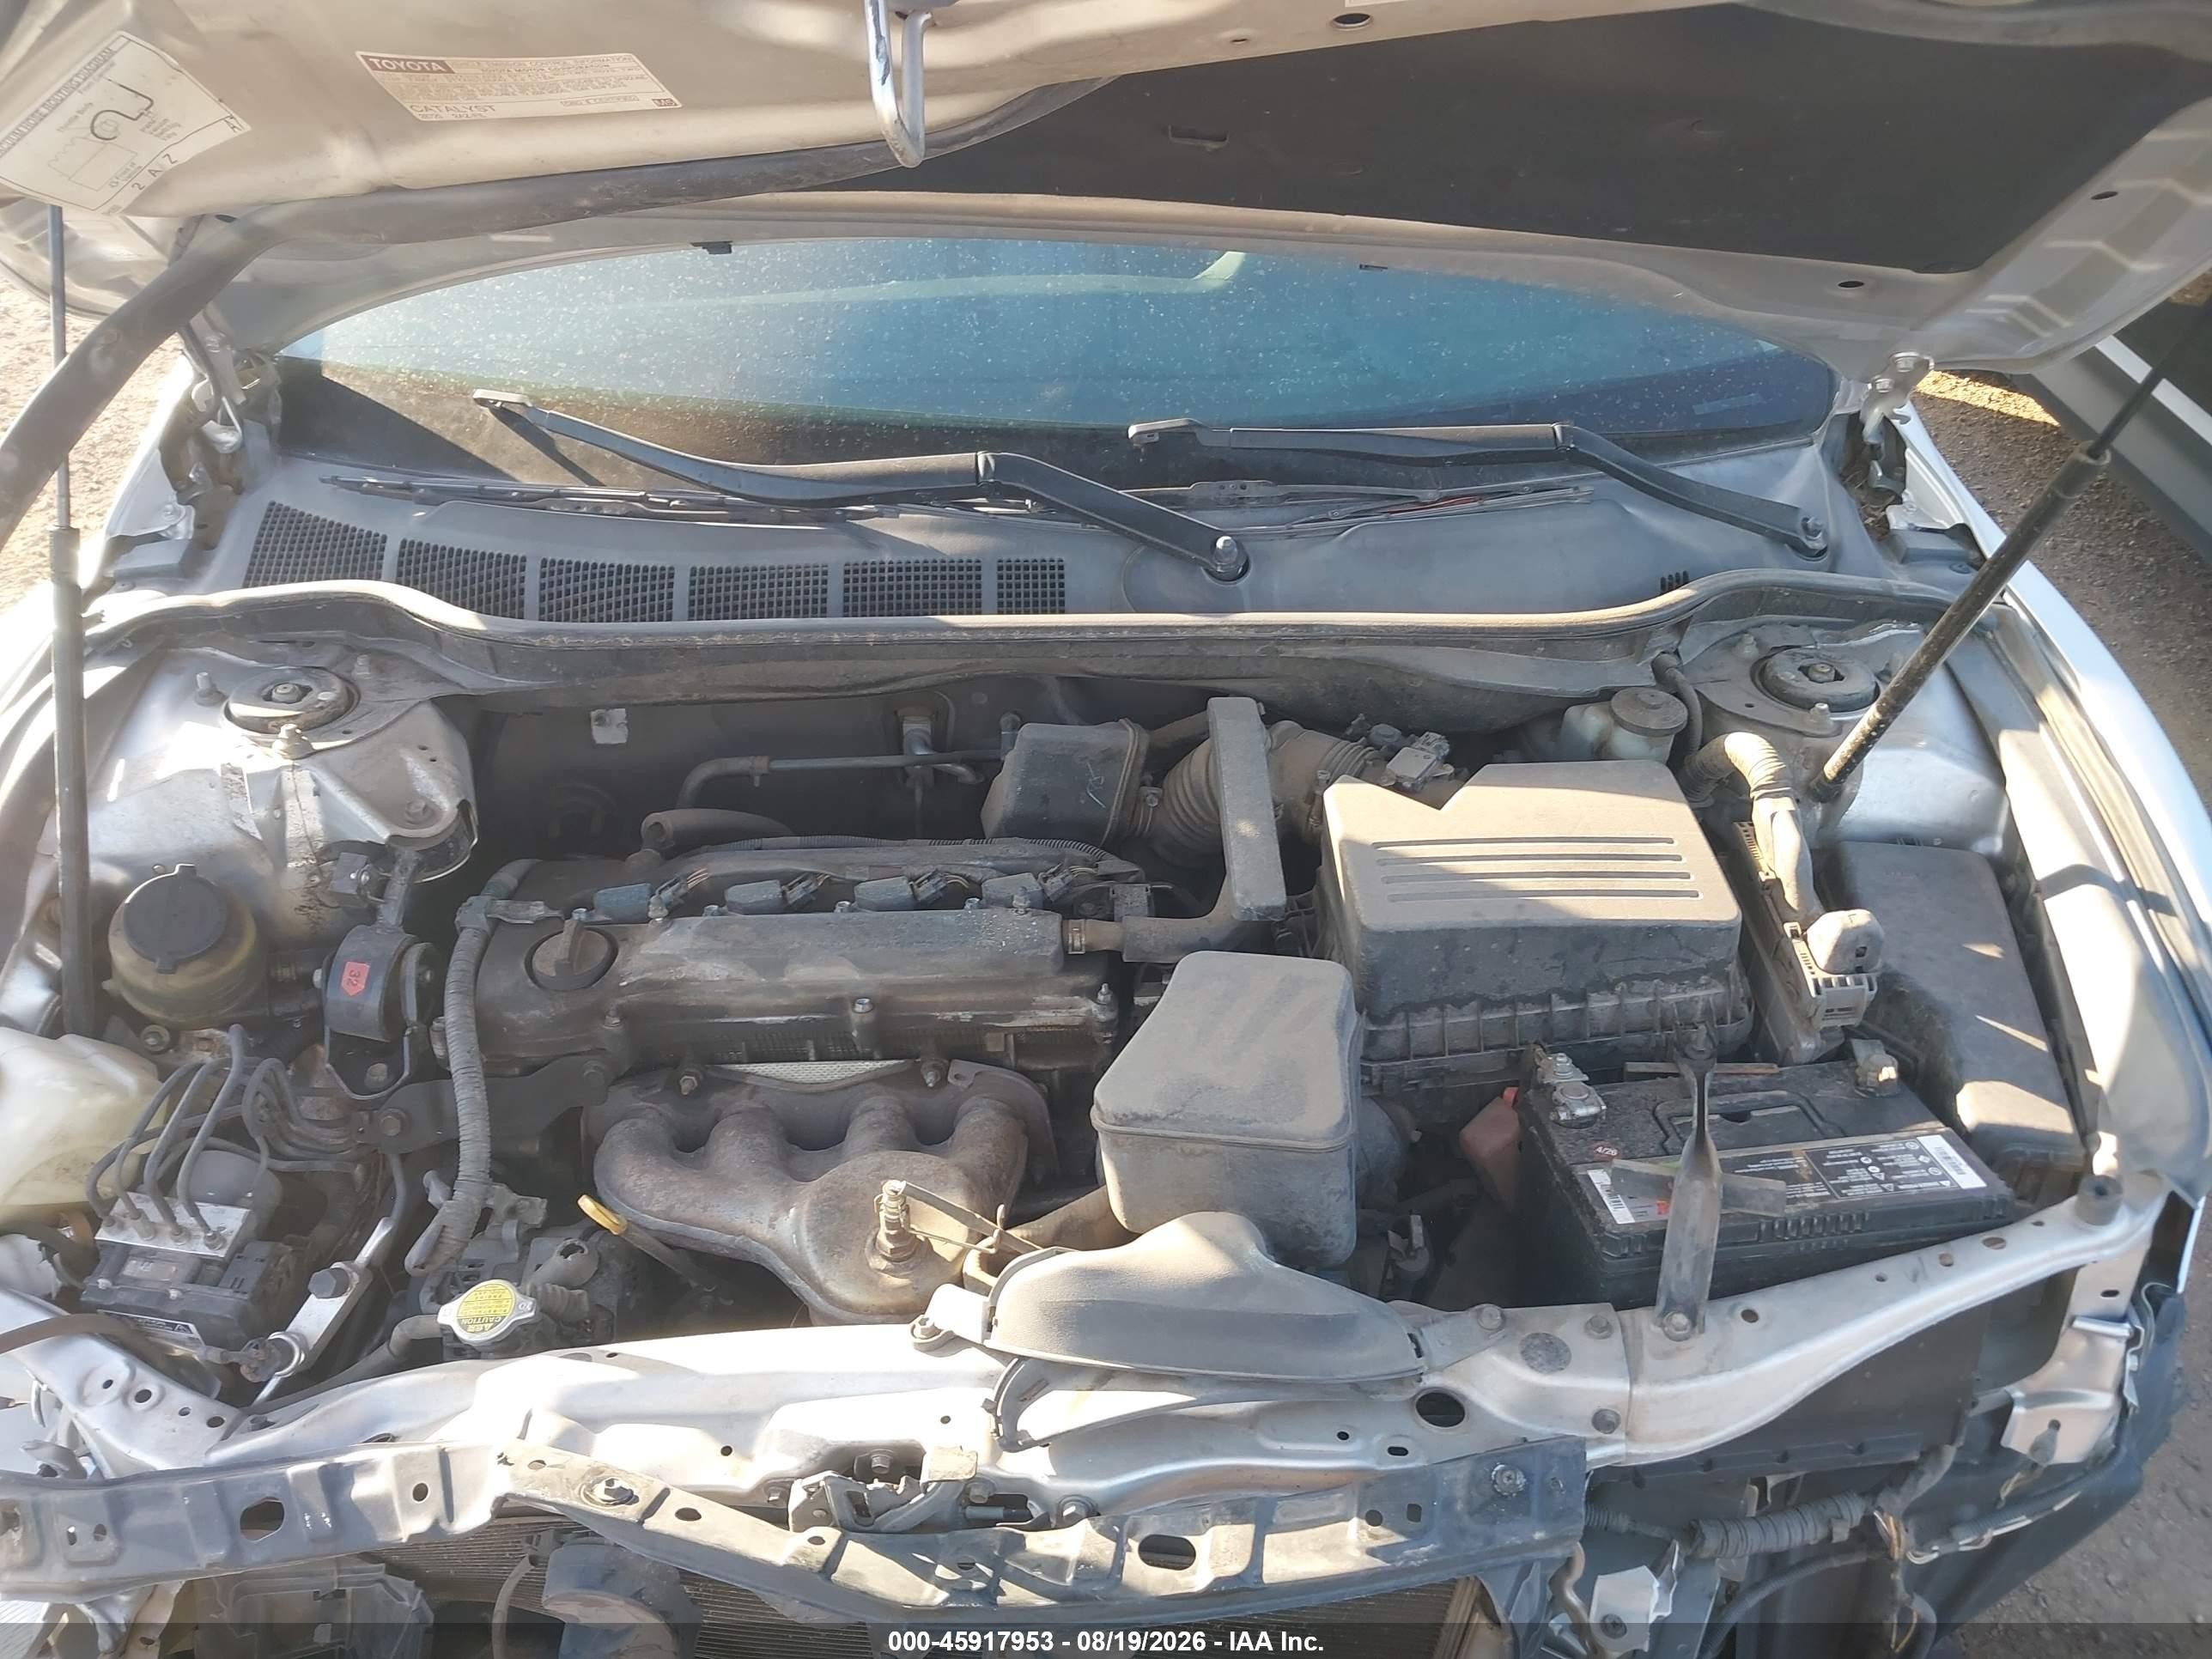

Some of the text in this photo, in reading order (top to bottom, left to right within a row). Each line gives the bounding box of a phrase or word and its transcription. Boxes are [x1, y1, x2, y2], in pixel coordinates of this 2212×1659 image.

[368, 58, 447, 72] TOYOTA
[410, 104, 496, 113] CATALYST
[461, 1316, 502, 1326] CAUTION
